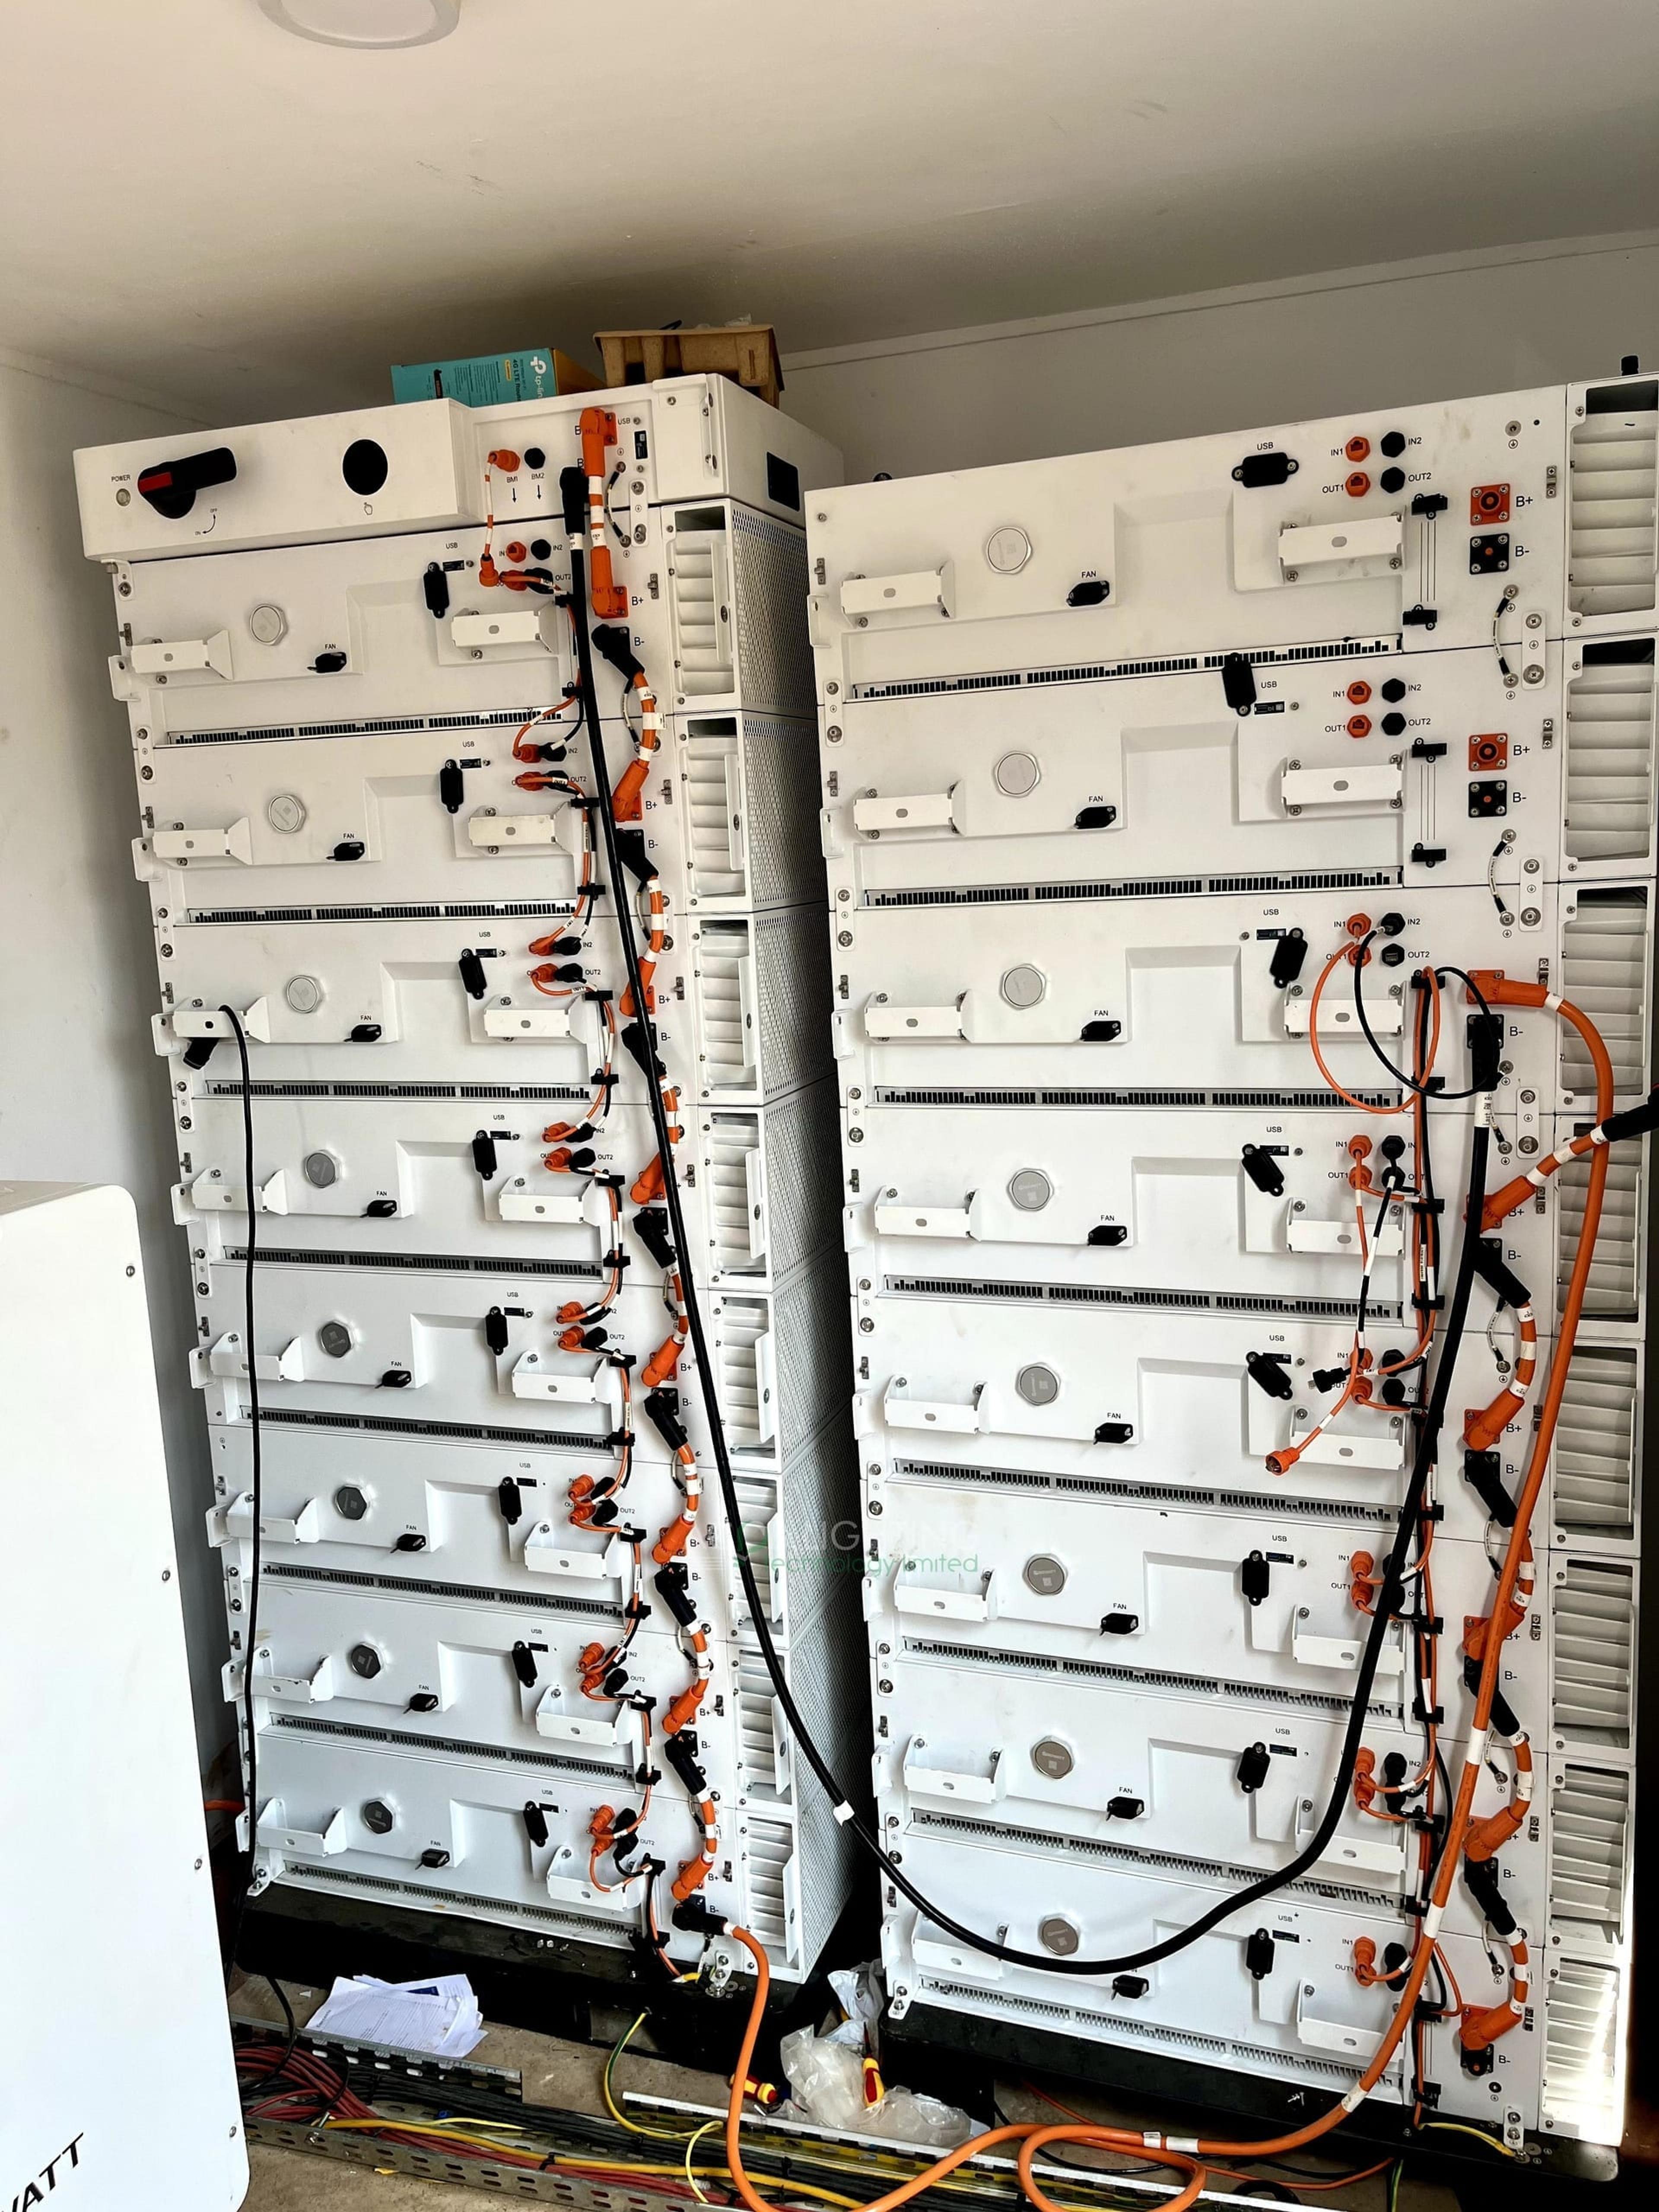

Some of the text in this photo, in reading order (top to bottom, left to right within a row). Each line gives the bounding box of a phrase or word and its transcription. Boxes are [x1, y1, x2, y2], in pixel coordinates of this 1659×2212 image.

[1257, 442, 1273, 450] USB
[1408, 473, 1431, 482] OUT2
[1322, 484, 1343, 493] OUT1
[1516, 496, 1533, 507] B+
[1516, 546, 1529, 557] B-
[632, 597, 643, 605] B+
[634, 637, 644, 646] B-
[1514, 745, 1530, 756] B+
[1513, 792, 1526, 802] B-
[646, 801, 657, 809] B+
[648, 840, 658, 848] B-
[659, 995, 670, 1004] B+
[1510, 1027, 1523, 1036] B-
[661, 1033, 671, 1041] B-
[1508, 1208, 1524, 1217] B+
[1508, 1250, 1521, 1259] B-
[683, 1398, 691, 1406] B-
[1507, 1424, 1521, 1433] B+
[1506, 1465, 1519, 1474] B-
[1505, 1671, 1517, 1680] B-
[1503, 1869, 1516, 1878] B-
[1499, 2055, 1510, 2063] B-
